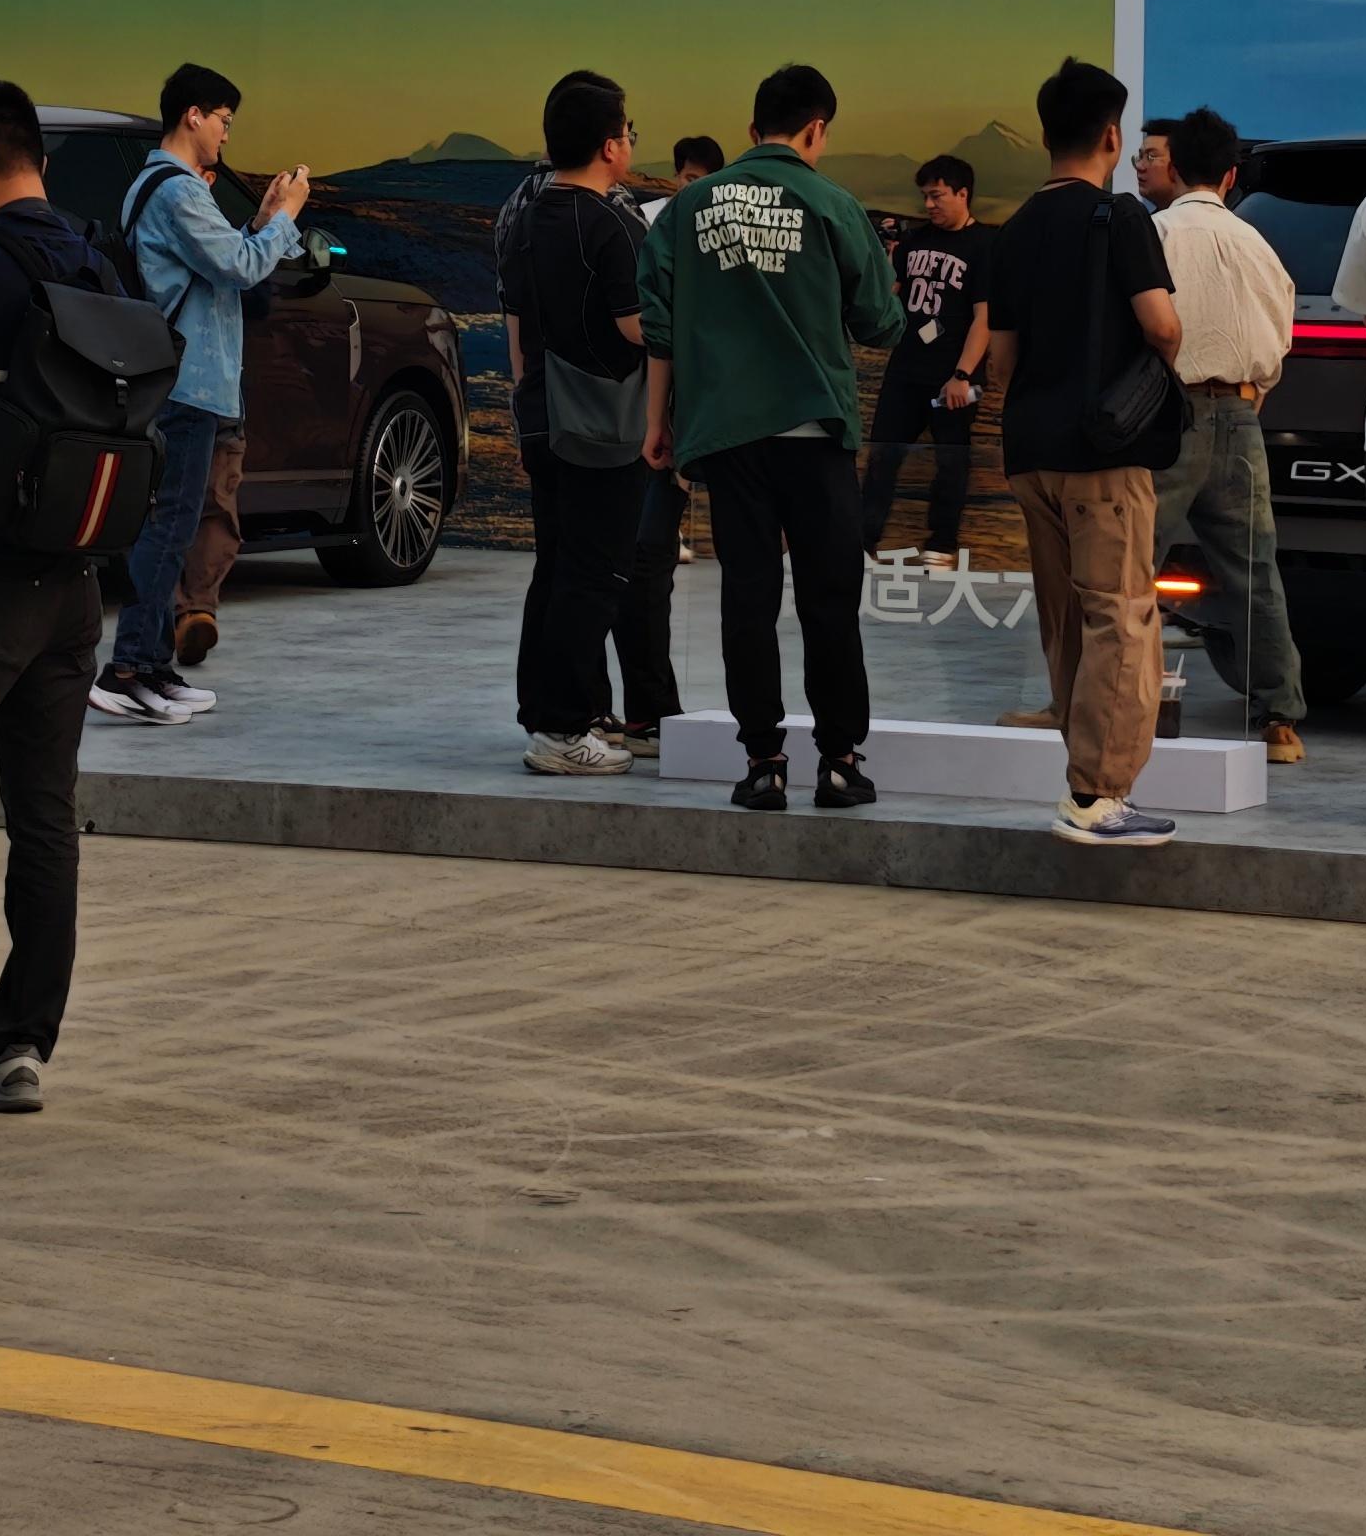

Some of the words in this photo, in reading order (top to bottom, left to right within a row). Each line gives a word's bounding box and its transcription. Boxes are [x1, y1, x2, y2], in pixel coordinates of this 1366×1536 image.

[712, 184, 783, 206] NOBODY
[695, 202, 803, 231] APPRECIATES
[698, 223, 741, 254] GOOD
[717, 244, 786, 273] ANYORE
[1290, 460, 1366, 484] GX
